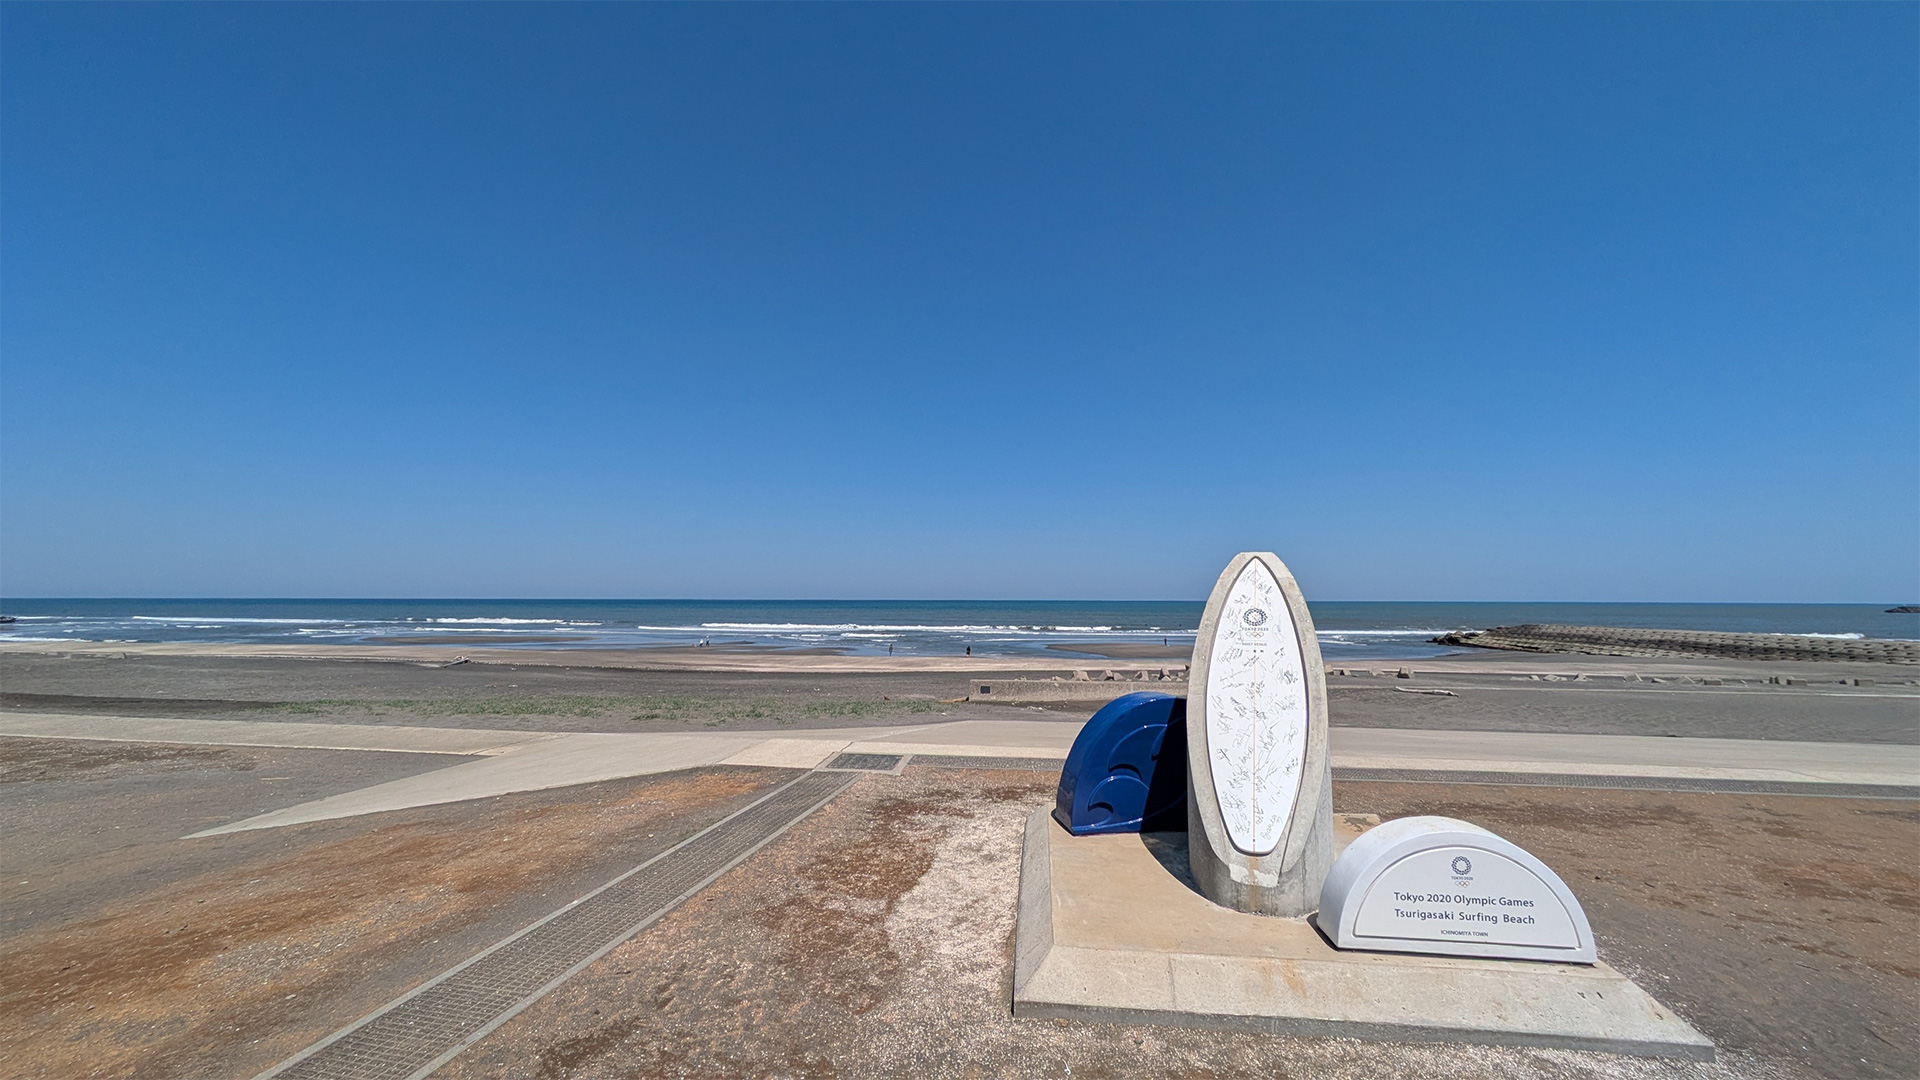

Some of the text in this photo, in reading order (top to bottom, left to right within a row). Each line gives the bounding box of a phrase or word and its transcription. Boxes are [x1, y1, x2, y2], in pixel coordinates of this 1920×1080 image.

[1394, 892, 1534, 907] Tokyo 2020 Olympic Games
[1394, 908, 1535, 924] Tsurigasaki Surfing Beach
